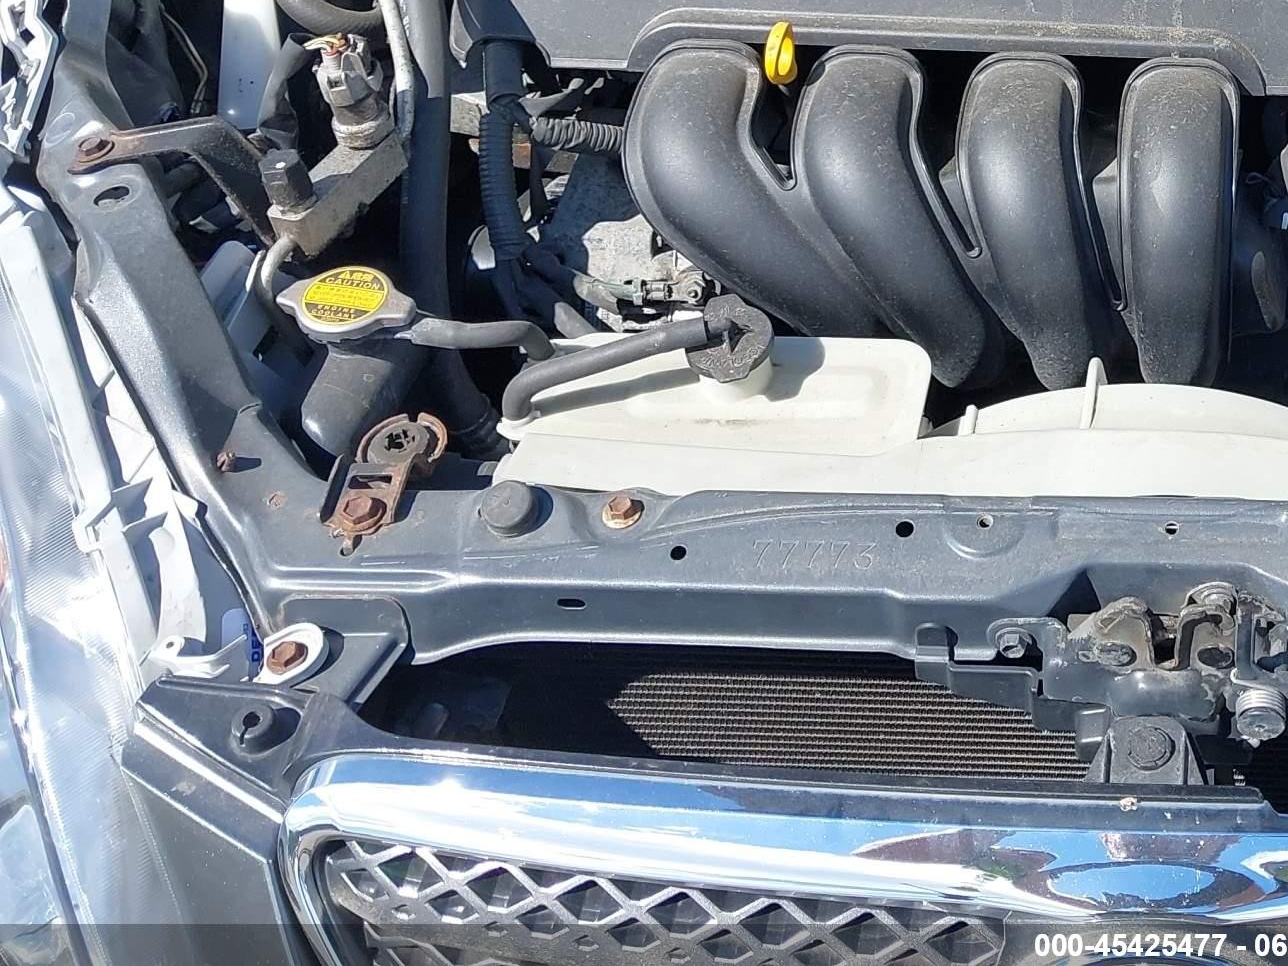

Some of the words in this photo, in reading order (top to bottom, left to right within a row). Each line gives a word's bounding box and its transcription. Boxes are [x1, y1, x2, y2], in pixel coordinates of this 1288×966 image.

[325, 276, 380, 290] CAUTION
[311, 309, 357, 319] COOLANT
[317, 304, 355, 314] ENGINE
[752, 537, 878, 570] 77773
